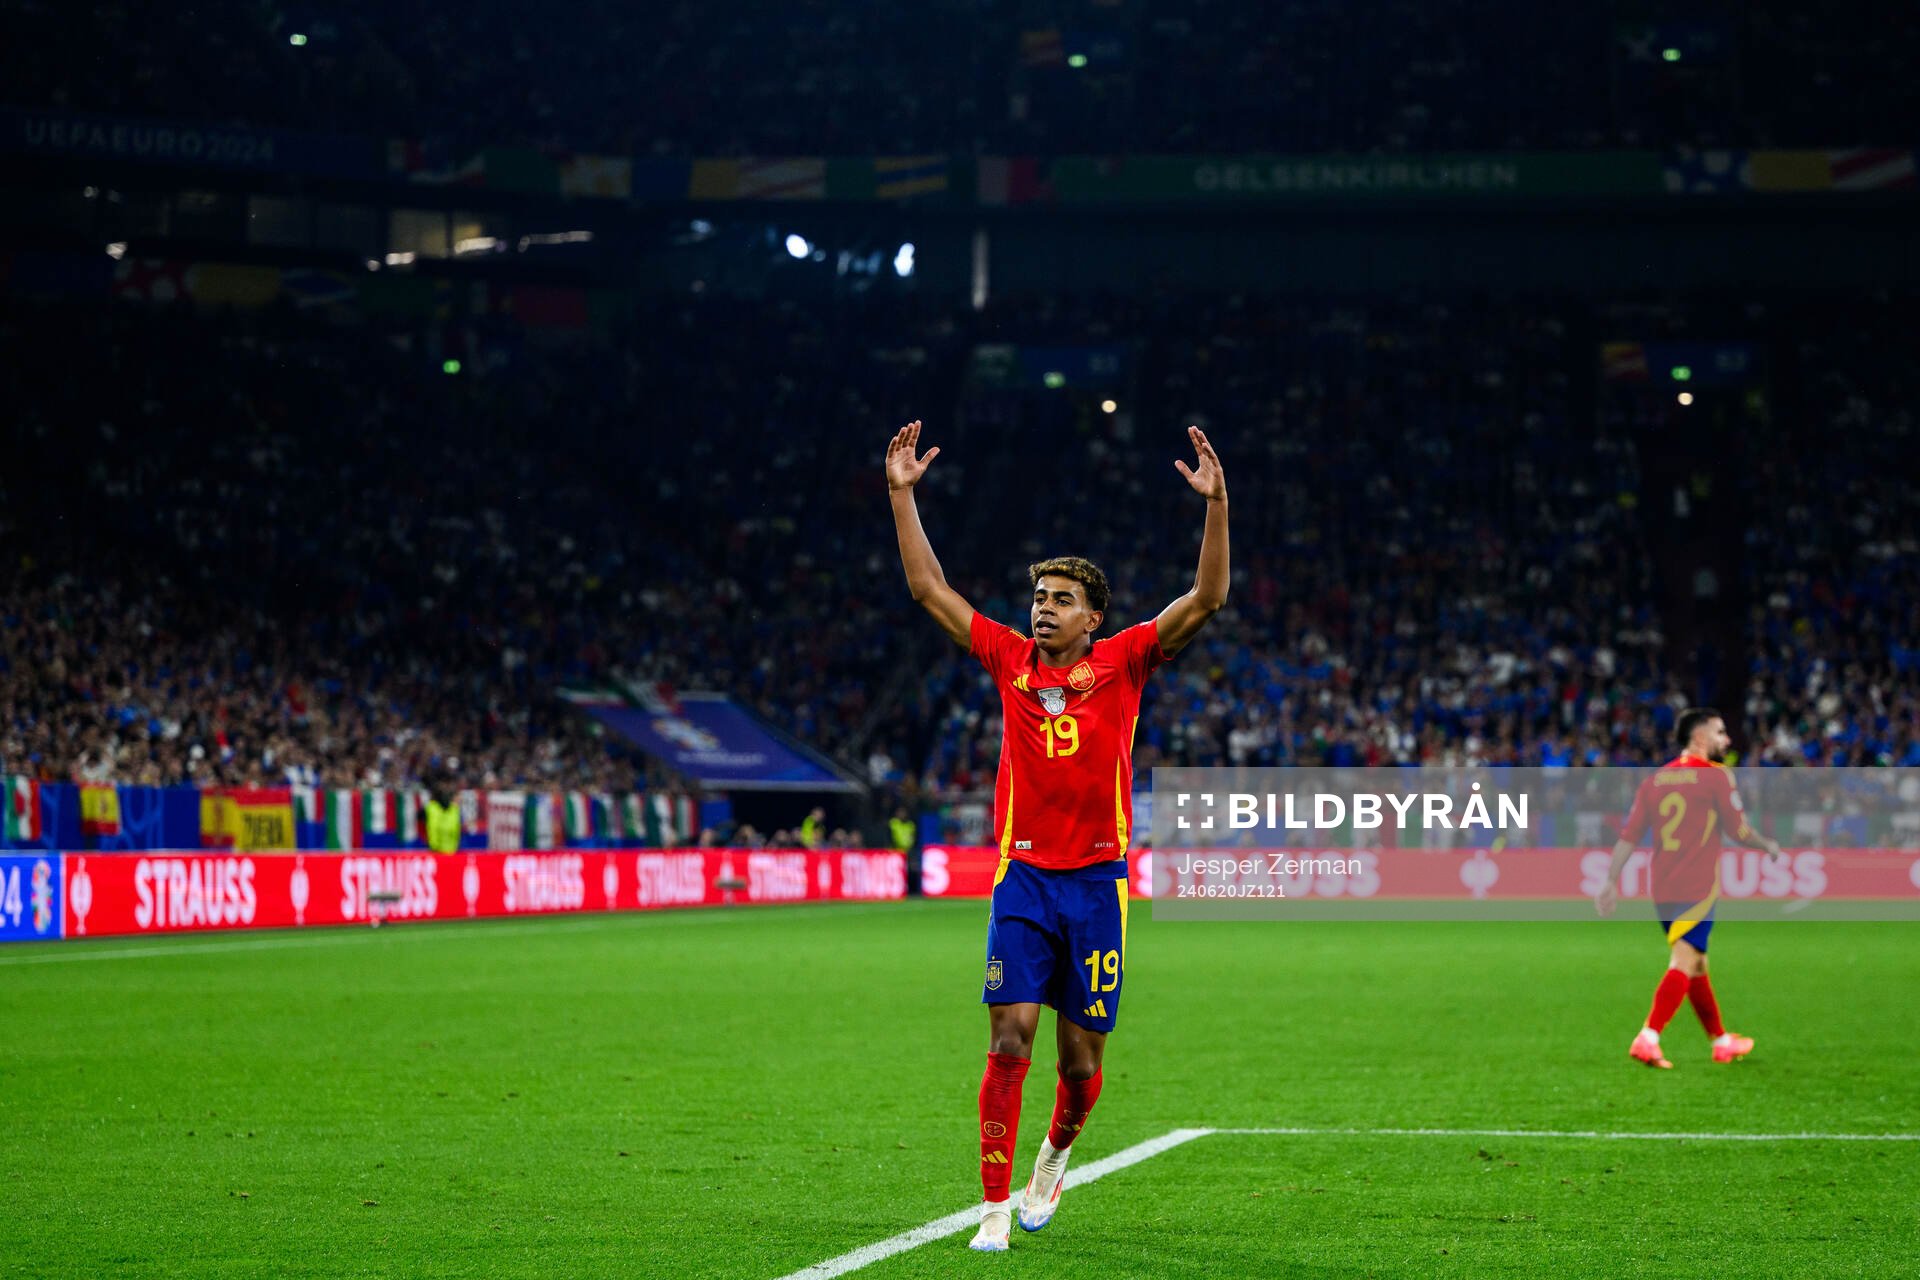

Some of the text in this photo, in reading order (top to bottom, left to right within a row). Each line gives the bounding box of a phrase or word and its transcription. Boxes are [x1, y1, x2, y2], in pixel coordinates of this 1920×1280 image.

[1039, 714, 1080, 758] 19
[1659, 791, 1686, 851] 2
[134, 857, 257, 928] STRAUSS
[340, 856, 438, 920] STRAUSS
[503, 853, 585, 912] STRAUSS
[1580, 851, 1828, 898] STUSS
[1085, 950, 1120, 992] 19
